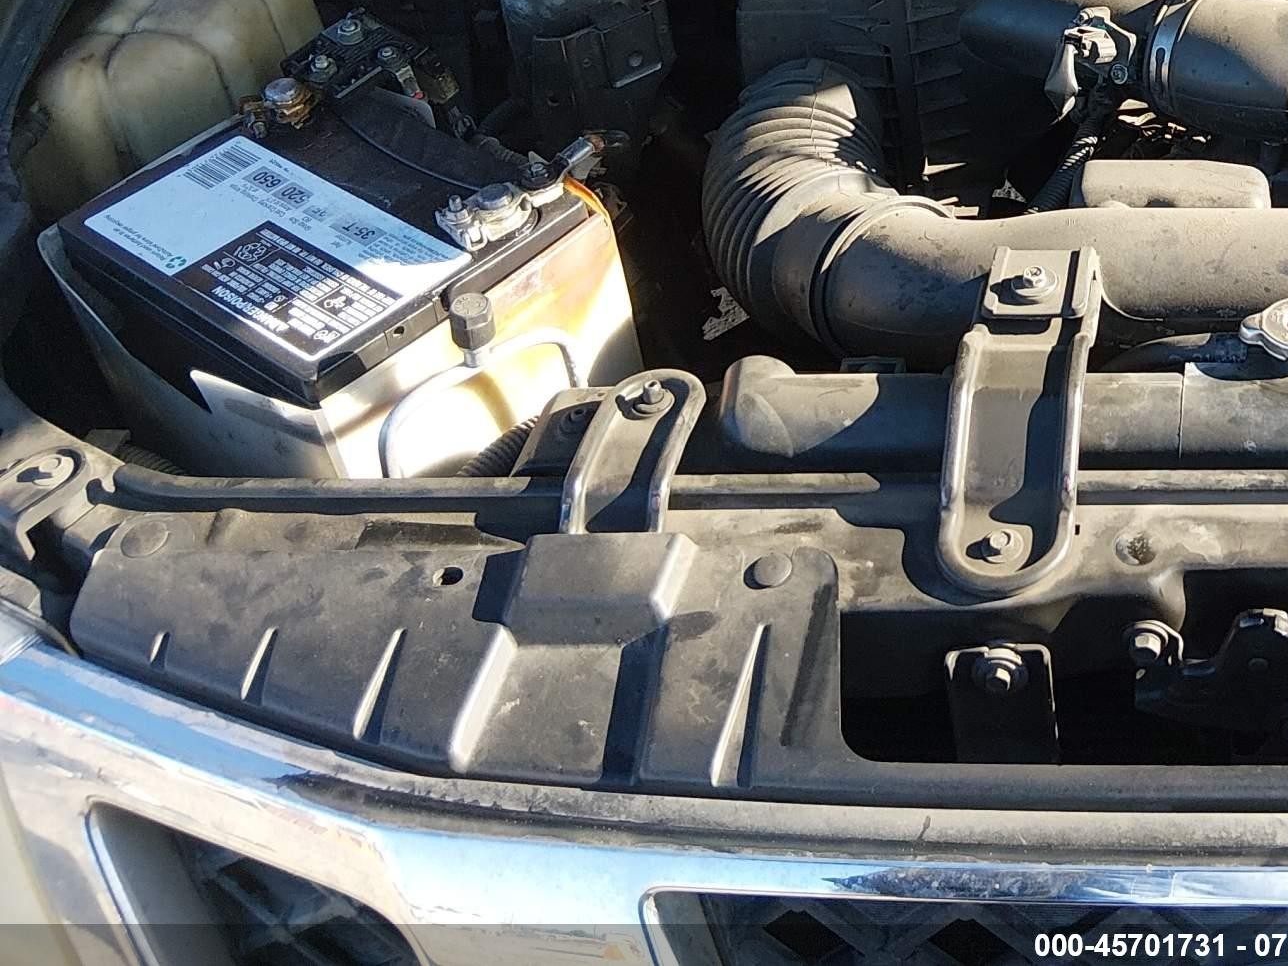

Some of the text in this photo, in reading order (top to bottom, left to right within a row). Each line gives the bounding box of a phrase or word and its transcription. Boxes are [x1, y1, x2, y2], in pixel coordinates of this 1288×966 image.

[249, 170, 283, 188] 650
[278, 185, 312, 204] 520
[340, 220, 377, 240] 35-T
